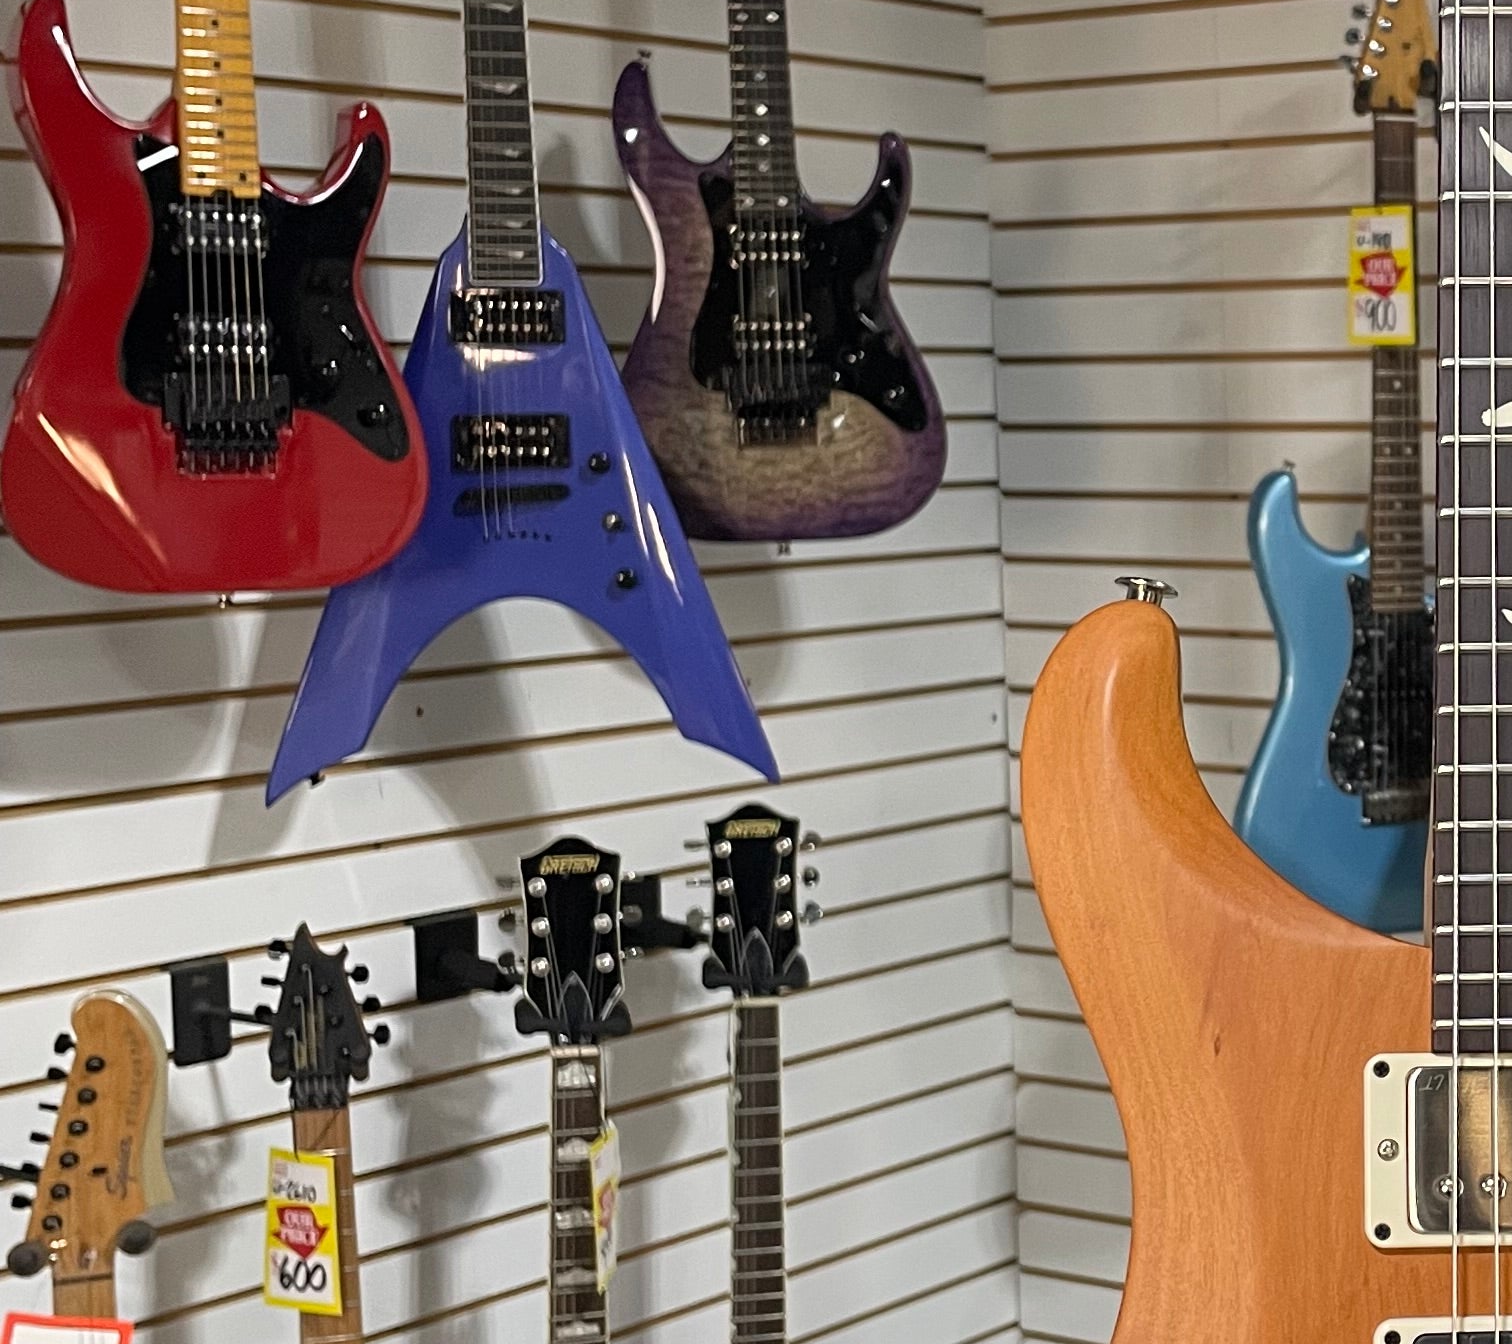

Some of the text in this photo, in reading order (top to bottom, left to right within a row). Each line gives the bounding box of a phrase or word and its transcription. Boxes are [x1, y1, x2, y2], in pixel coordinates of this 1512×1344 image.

[1367, 258, 1395, 274] OUR
[1355, 297, 1397, 332] $900
[283, 1209, 313, 1227] OUR
[279, 1226, 320, 1247] PRICE
[270, 1250, 328, 1293] $600
